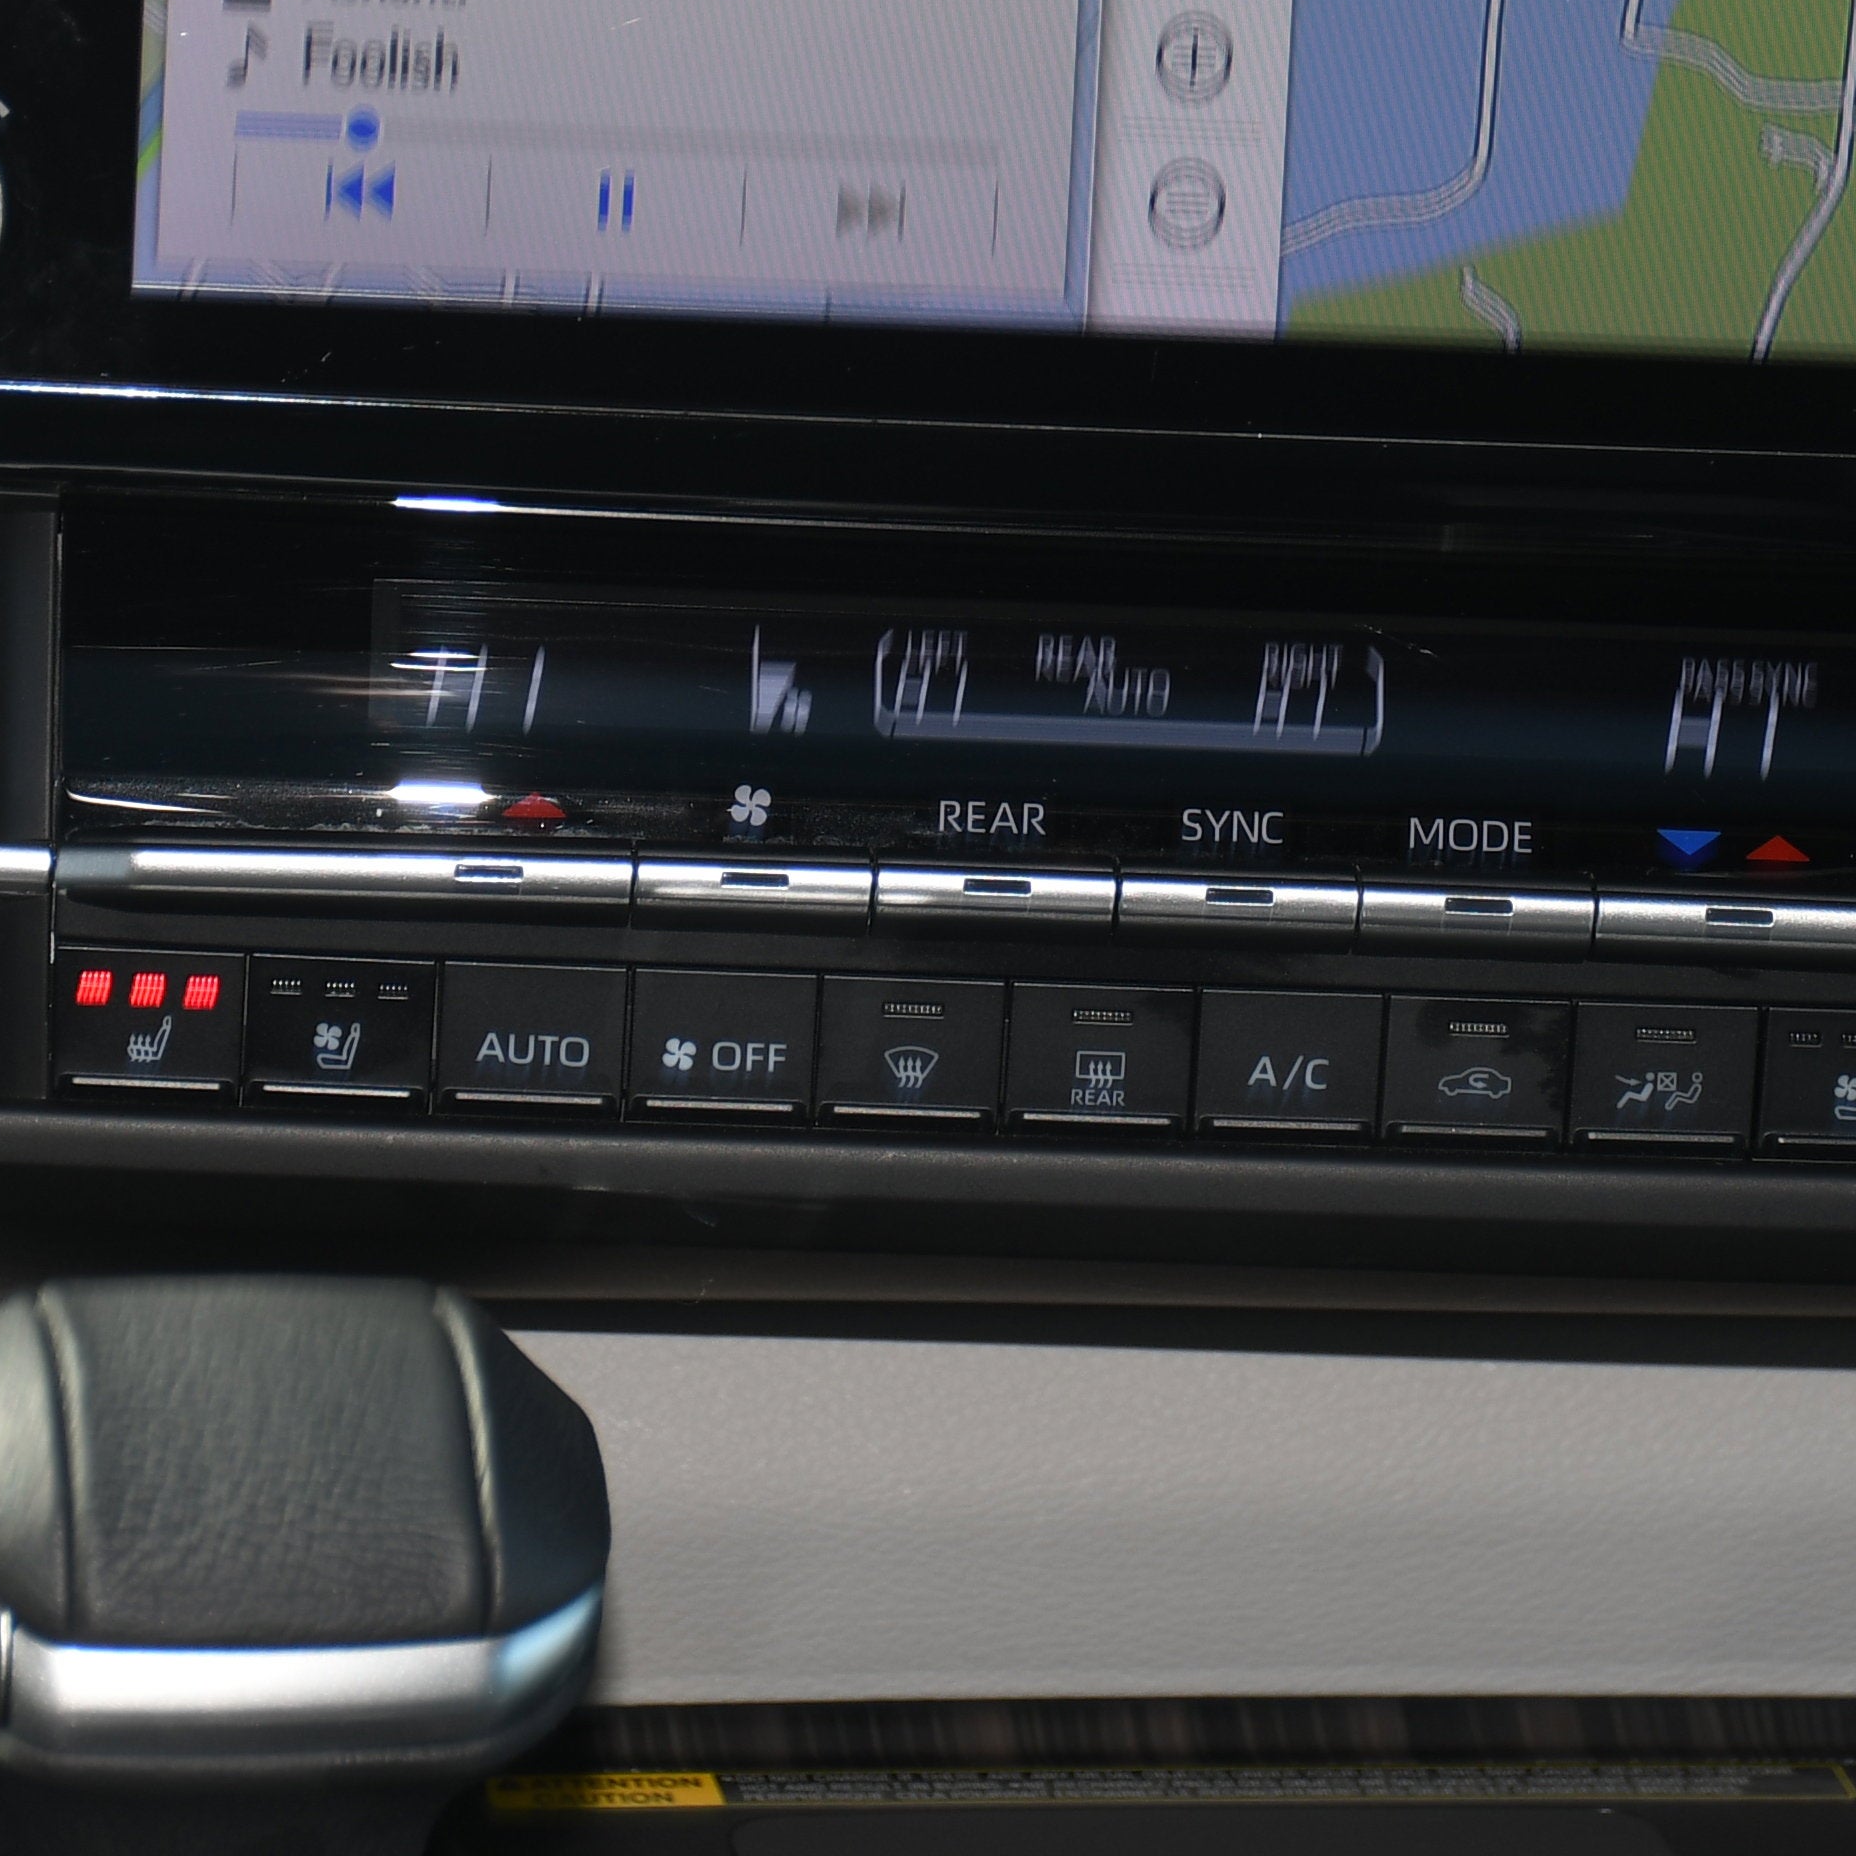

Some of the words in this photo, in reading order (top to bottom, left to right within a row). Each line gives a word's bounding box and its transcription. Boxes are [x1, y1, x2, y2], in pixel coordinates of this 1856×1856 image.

[302, 20, 461, 97] Foolish
[1034, 633, 1116, 684] REAR
[937, 799, 1046, 837] REAR
[1180, 808, 1284, 846] SYNC
[1408, 816, 1534, 855] MODE
[475, 1030, 591, 1071] AUTO
[710, 1040, 789, 1075] OFF
[1246, 1054, 1330, 1092] A/C
[1070, 1088, 1126, 1108] REAR
